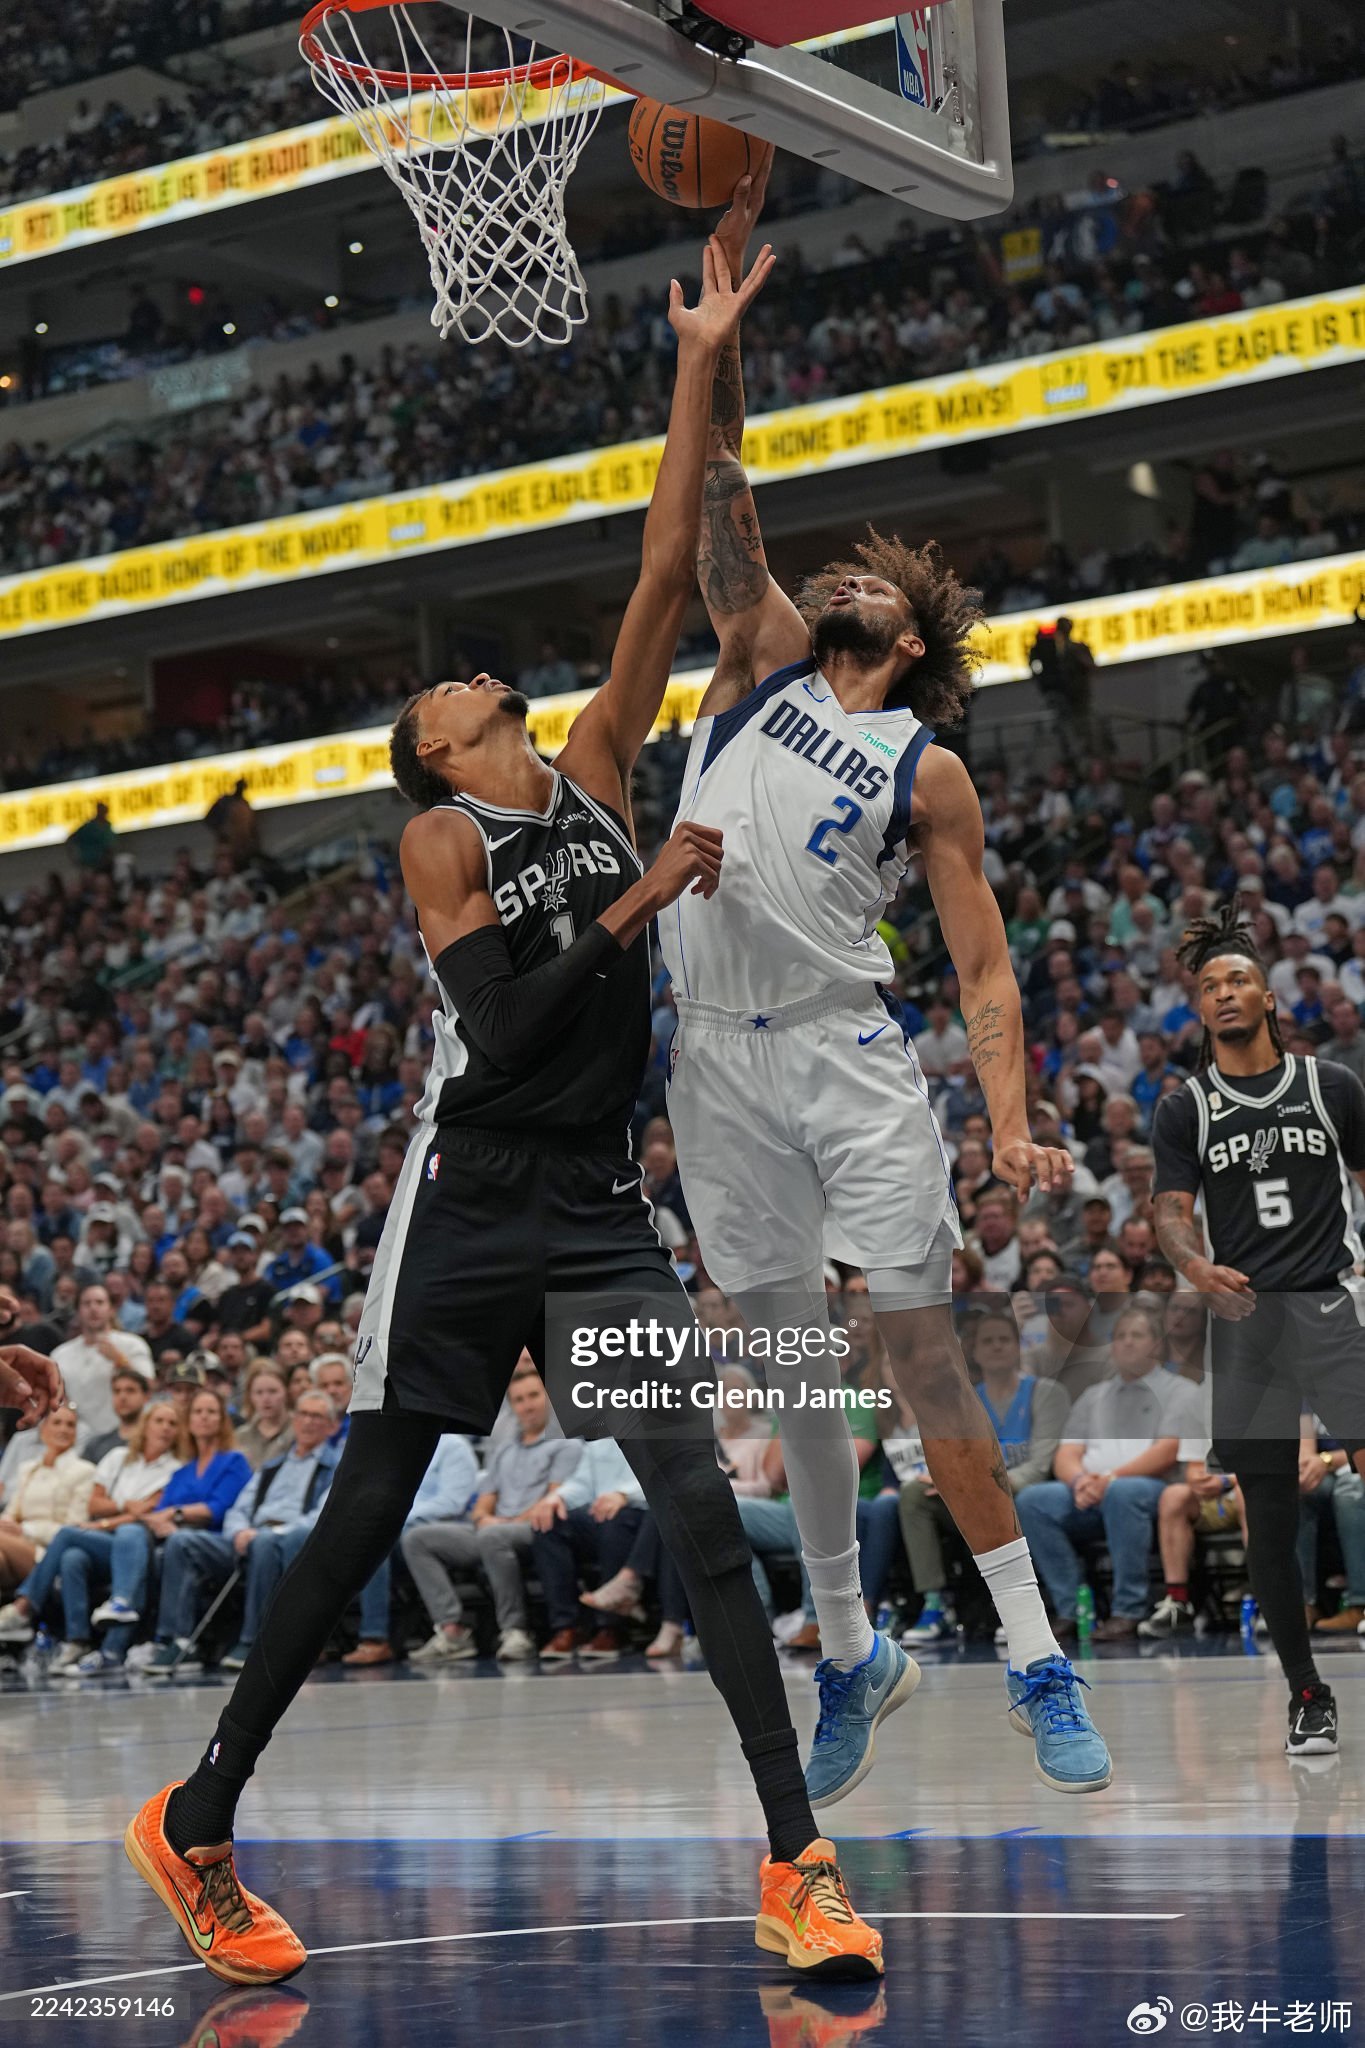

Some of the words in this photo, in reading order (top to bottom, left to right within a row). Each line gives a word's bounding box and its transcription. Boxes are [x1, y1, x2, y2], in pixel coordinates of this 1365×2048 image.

[903, 69, 920, 98] NBA
[64, 201, 97, 233] THE
[106, 177, 169, 222] EAGLE
[179, 174, 196, 200] IS
[206, 157, 243, 193] THE
[251, 142, 310, 184] RADIO
[660, 118, 688, 200] Wilson
[30, 588, 47, 615] IS
[56, 579, 88, 610] THE
[99, 567, 152, 598] RADIO
[162, 556, 213, 588] HOME
[222, 548, 245, 574] OF
[256, 540, 291, 568] THE
[484, 486, 521, 518] THE
[531, 470, 601, 512] EAGLE
[612, 463, 632, 493] IS
[767, 427, 828, 467] HOME
[842, 419, 867, 447] OF
[885, 402, 925, 435] THE
[934, 385, 1013, 425] MAVS!
[1158, 341, 1208, 383] THE
[1215, 320, 1303, 369] EAGLE
[1313, 314, 1338, 348] IS
[120, 783, 164, 815] HOME
[1103, 614, 1124, 644] IS
[1135, 608, 1171, 638] THE
[1183, 594, 1254, 631] RADIO
[1263, 577, 1328, 618] HOME
[760, 699, 891, 802] DALLAS
[804, 795, 863, 868] 2
[494, 840, 620, 926] SPURS
[550, 911, 576, 955] 1
[1208, 1126, 1327, 1173] SPURS
[1253, 1177, 1294, 1229] 5
